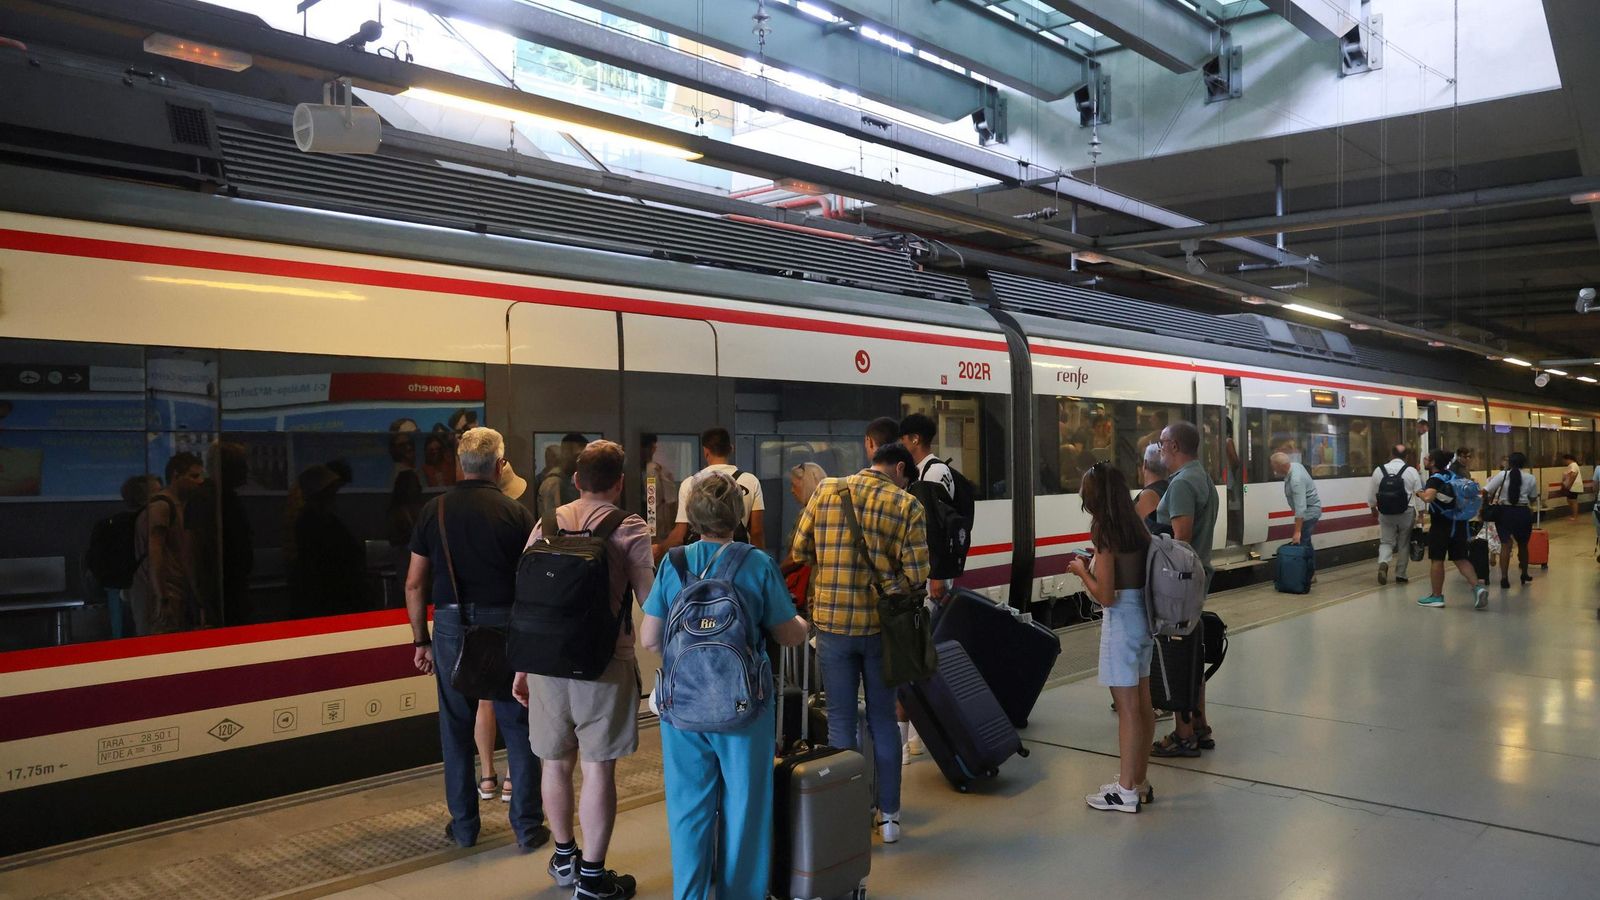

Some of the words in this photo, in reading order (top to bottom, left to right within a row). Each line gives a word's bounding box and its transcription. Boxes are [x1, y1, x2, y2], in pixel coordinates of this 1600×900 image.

[958, 361, 991, 380] 202R
[1056, 366, 1089, 390] renfe
[405, 696, 411, 707] E
[218, 723, 233, 737] 120
[102, 738, 125, 749] TARA
[151, 743, 162, 753] 36
